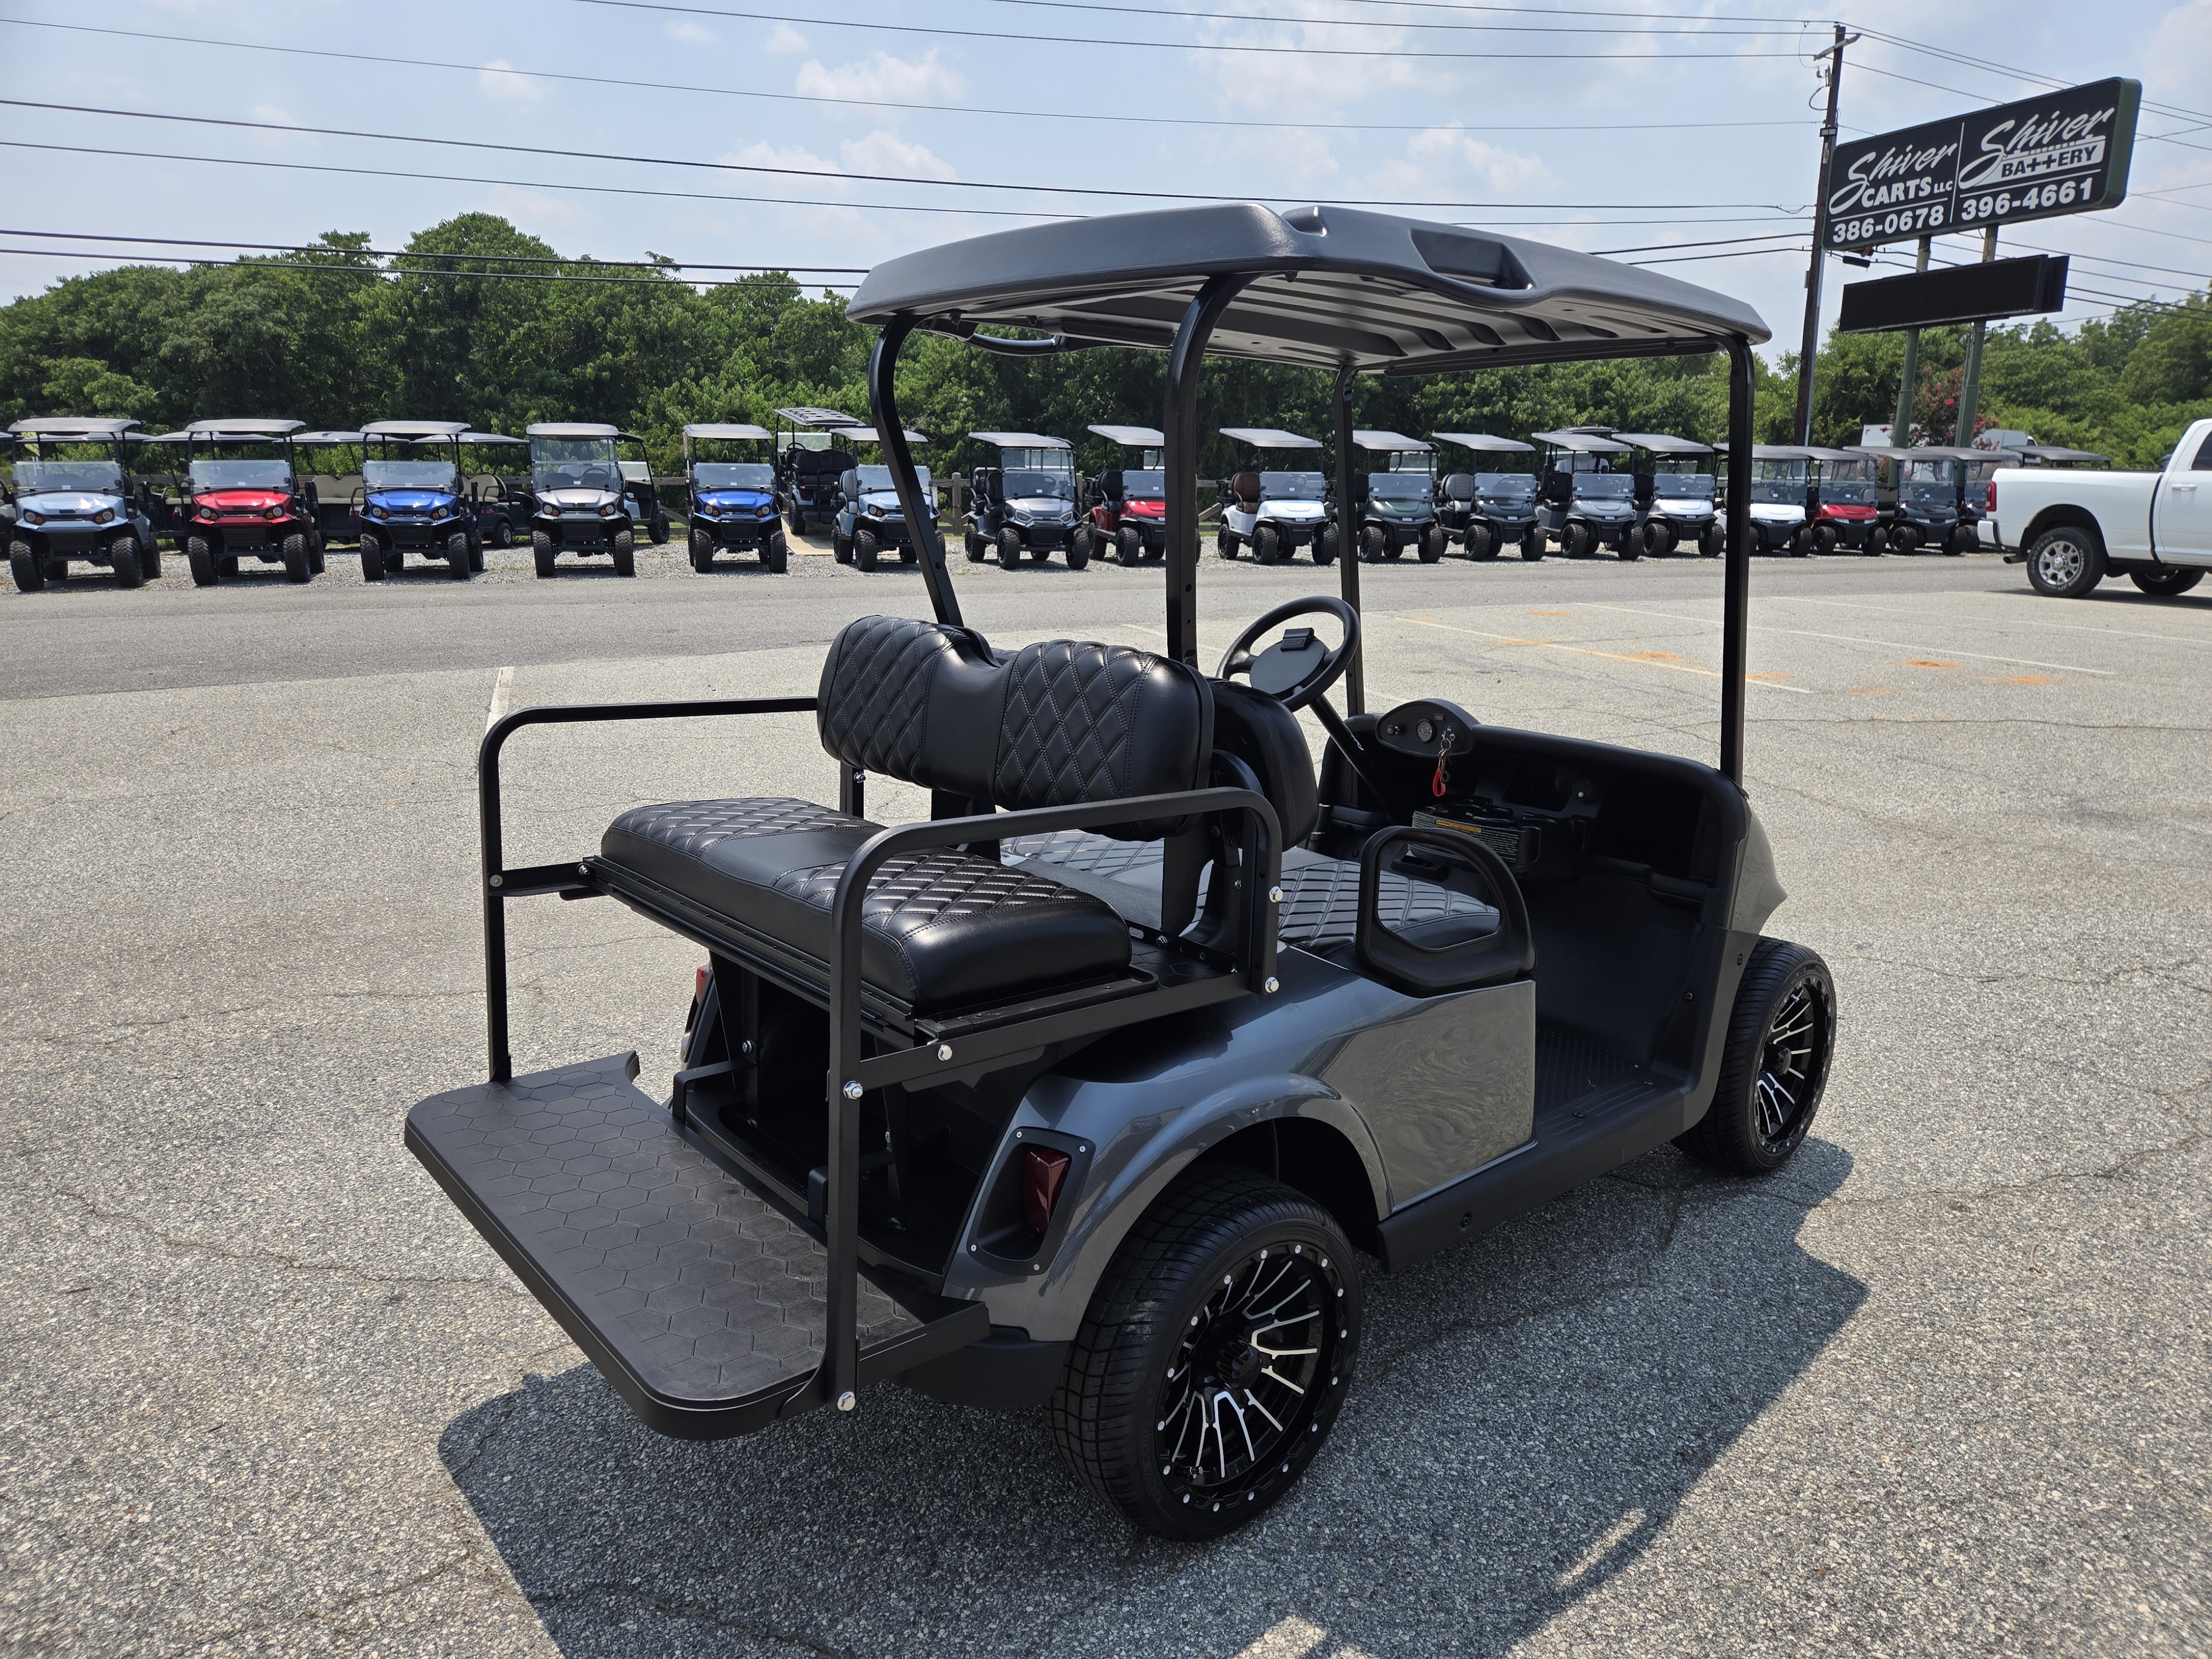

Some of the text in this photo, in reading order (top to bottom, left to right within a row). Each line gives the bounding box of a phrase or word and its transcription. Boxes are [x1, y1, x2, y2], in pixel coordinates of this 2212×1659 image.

[1958, 107, 2115, 190] Shiver
[1829, 143, 1958, 215] Shiver
[1861, 176, 1953, 208] CARTS LLC
[1961, 177, 2093, 221] 396-4661
[1832, 205, 1944, 243] 386-0678
